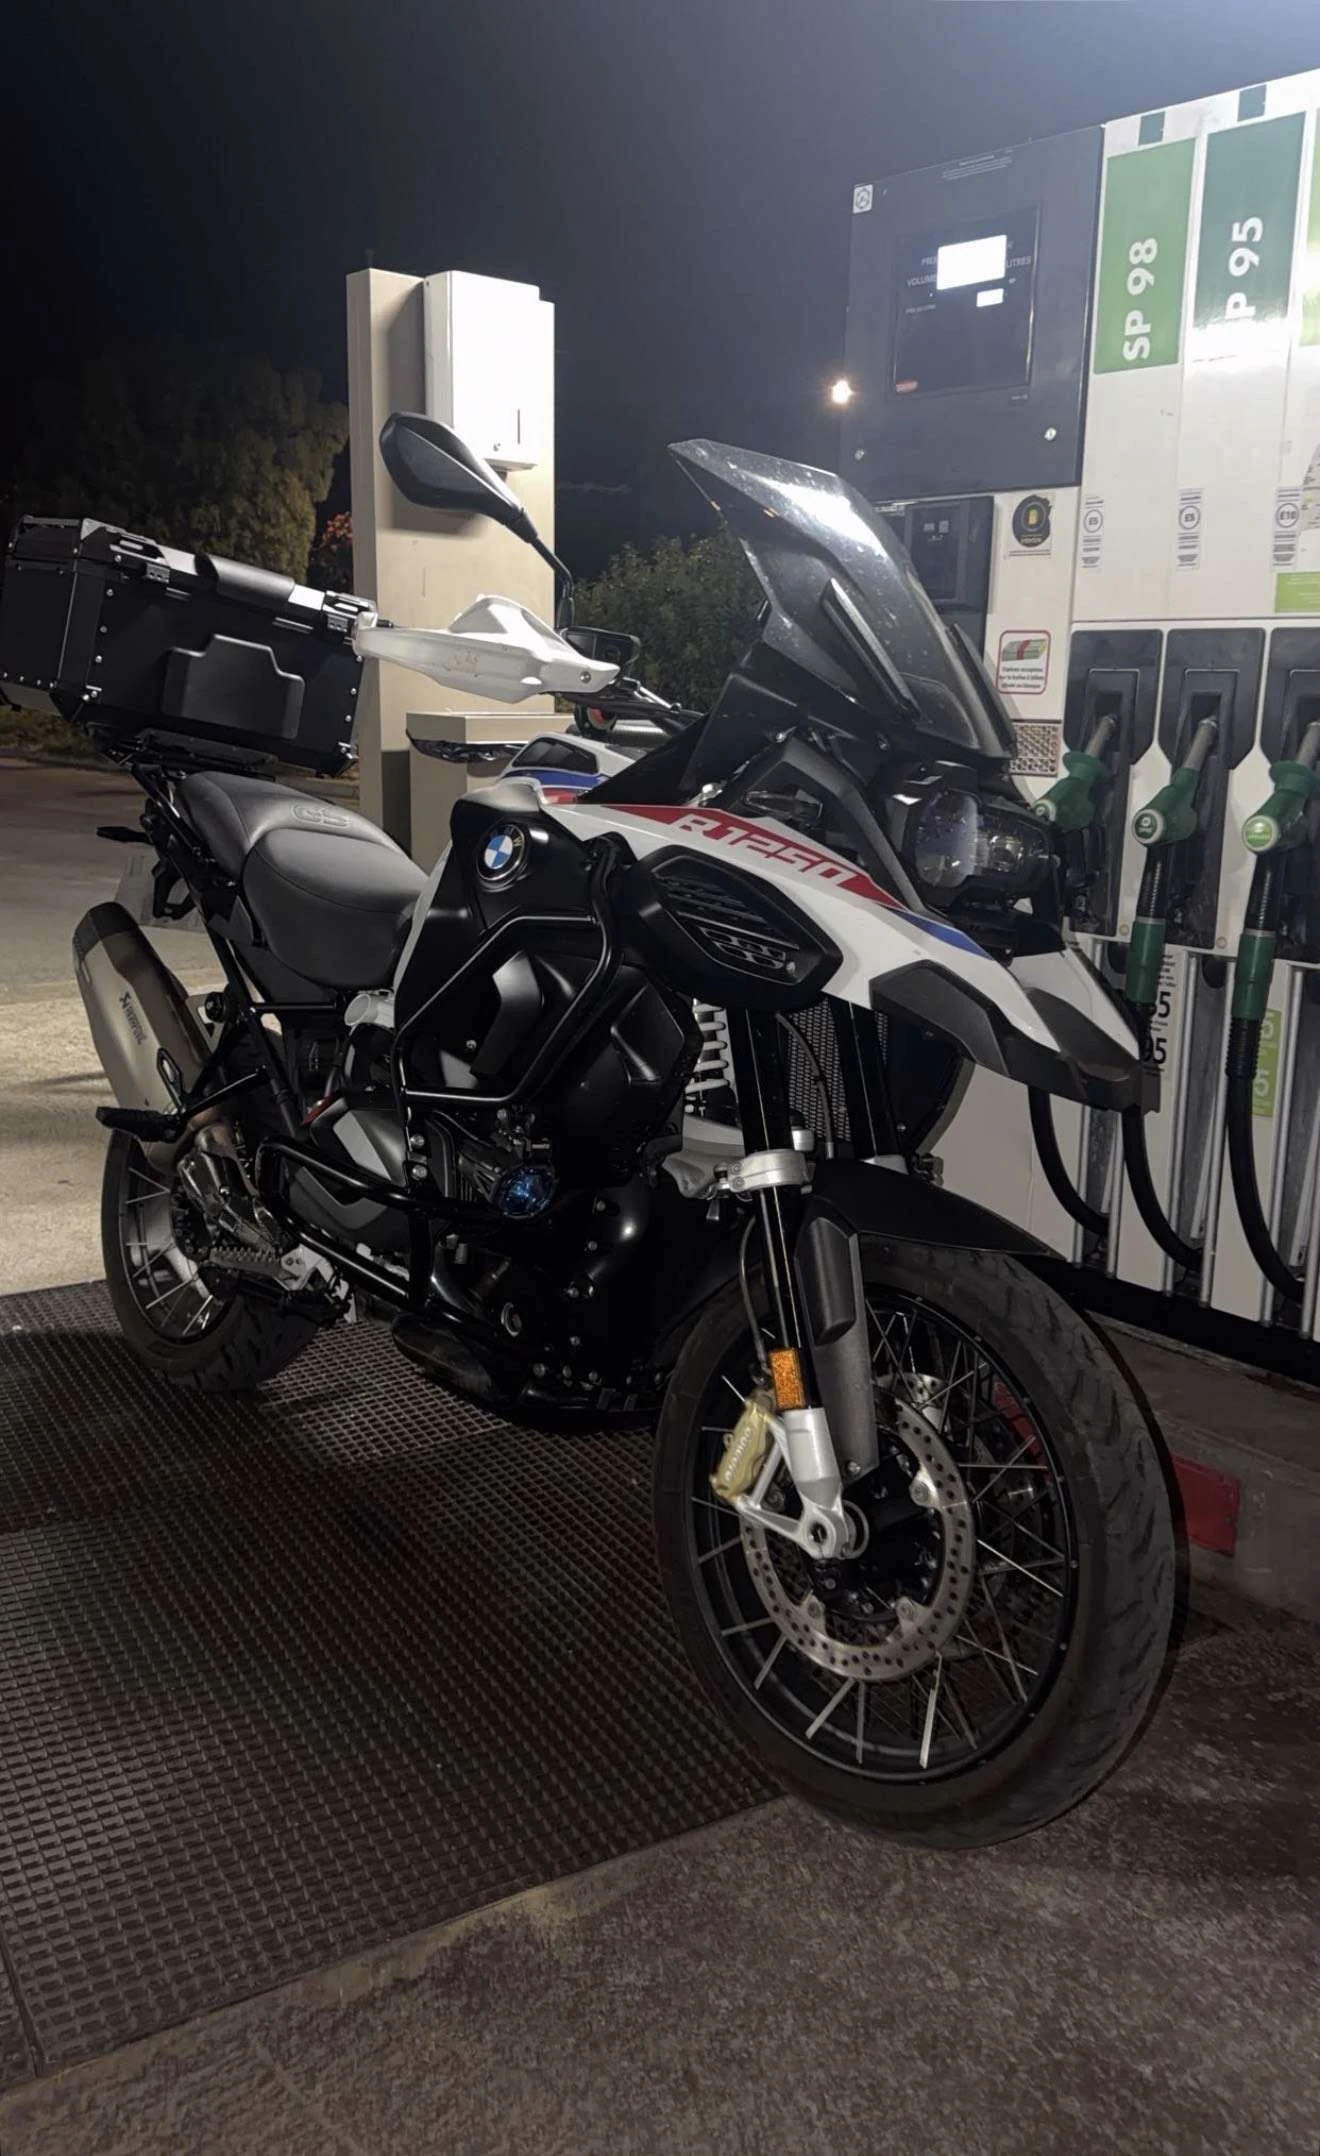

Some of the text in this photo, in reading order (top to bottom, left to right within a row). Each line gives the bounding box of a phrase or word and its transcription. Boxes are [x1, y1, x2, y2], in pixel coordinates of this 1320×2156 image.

[1228, 217, 1263, 277] 95
[1122, 238, 1158, 361] SP 98
[674, 813, 859, 888] R1250
